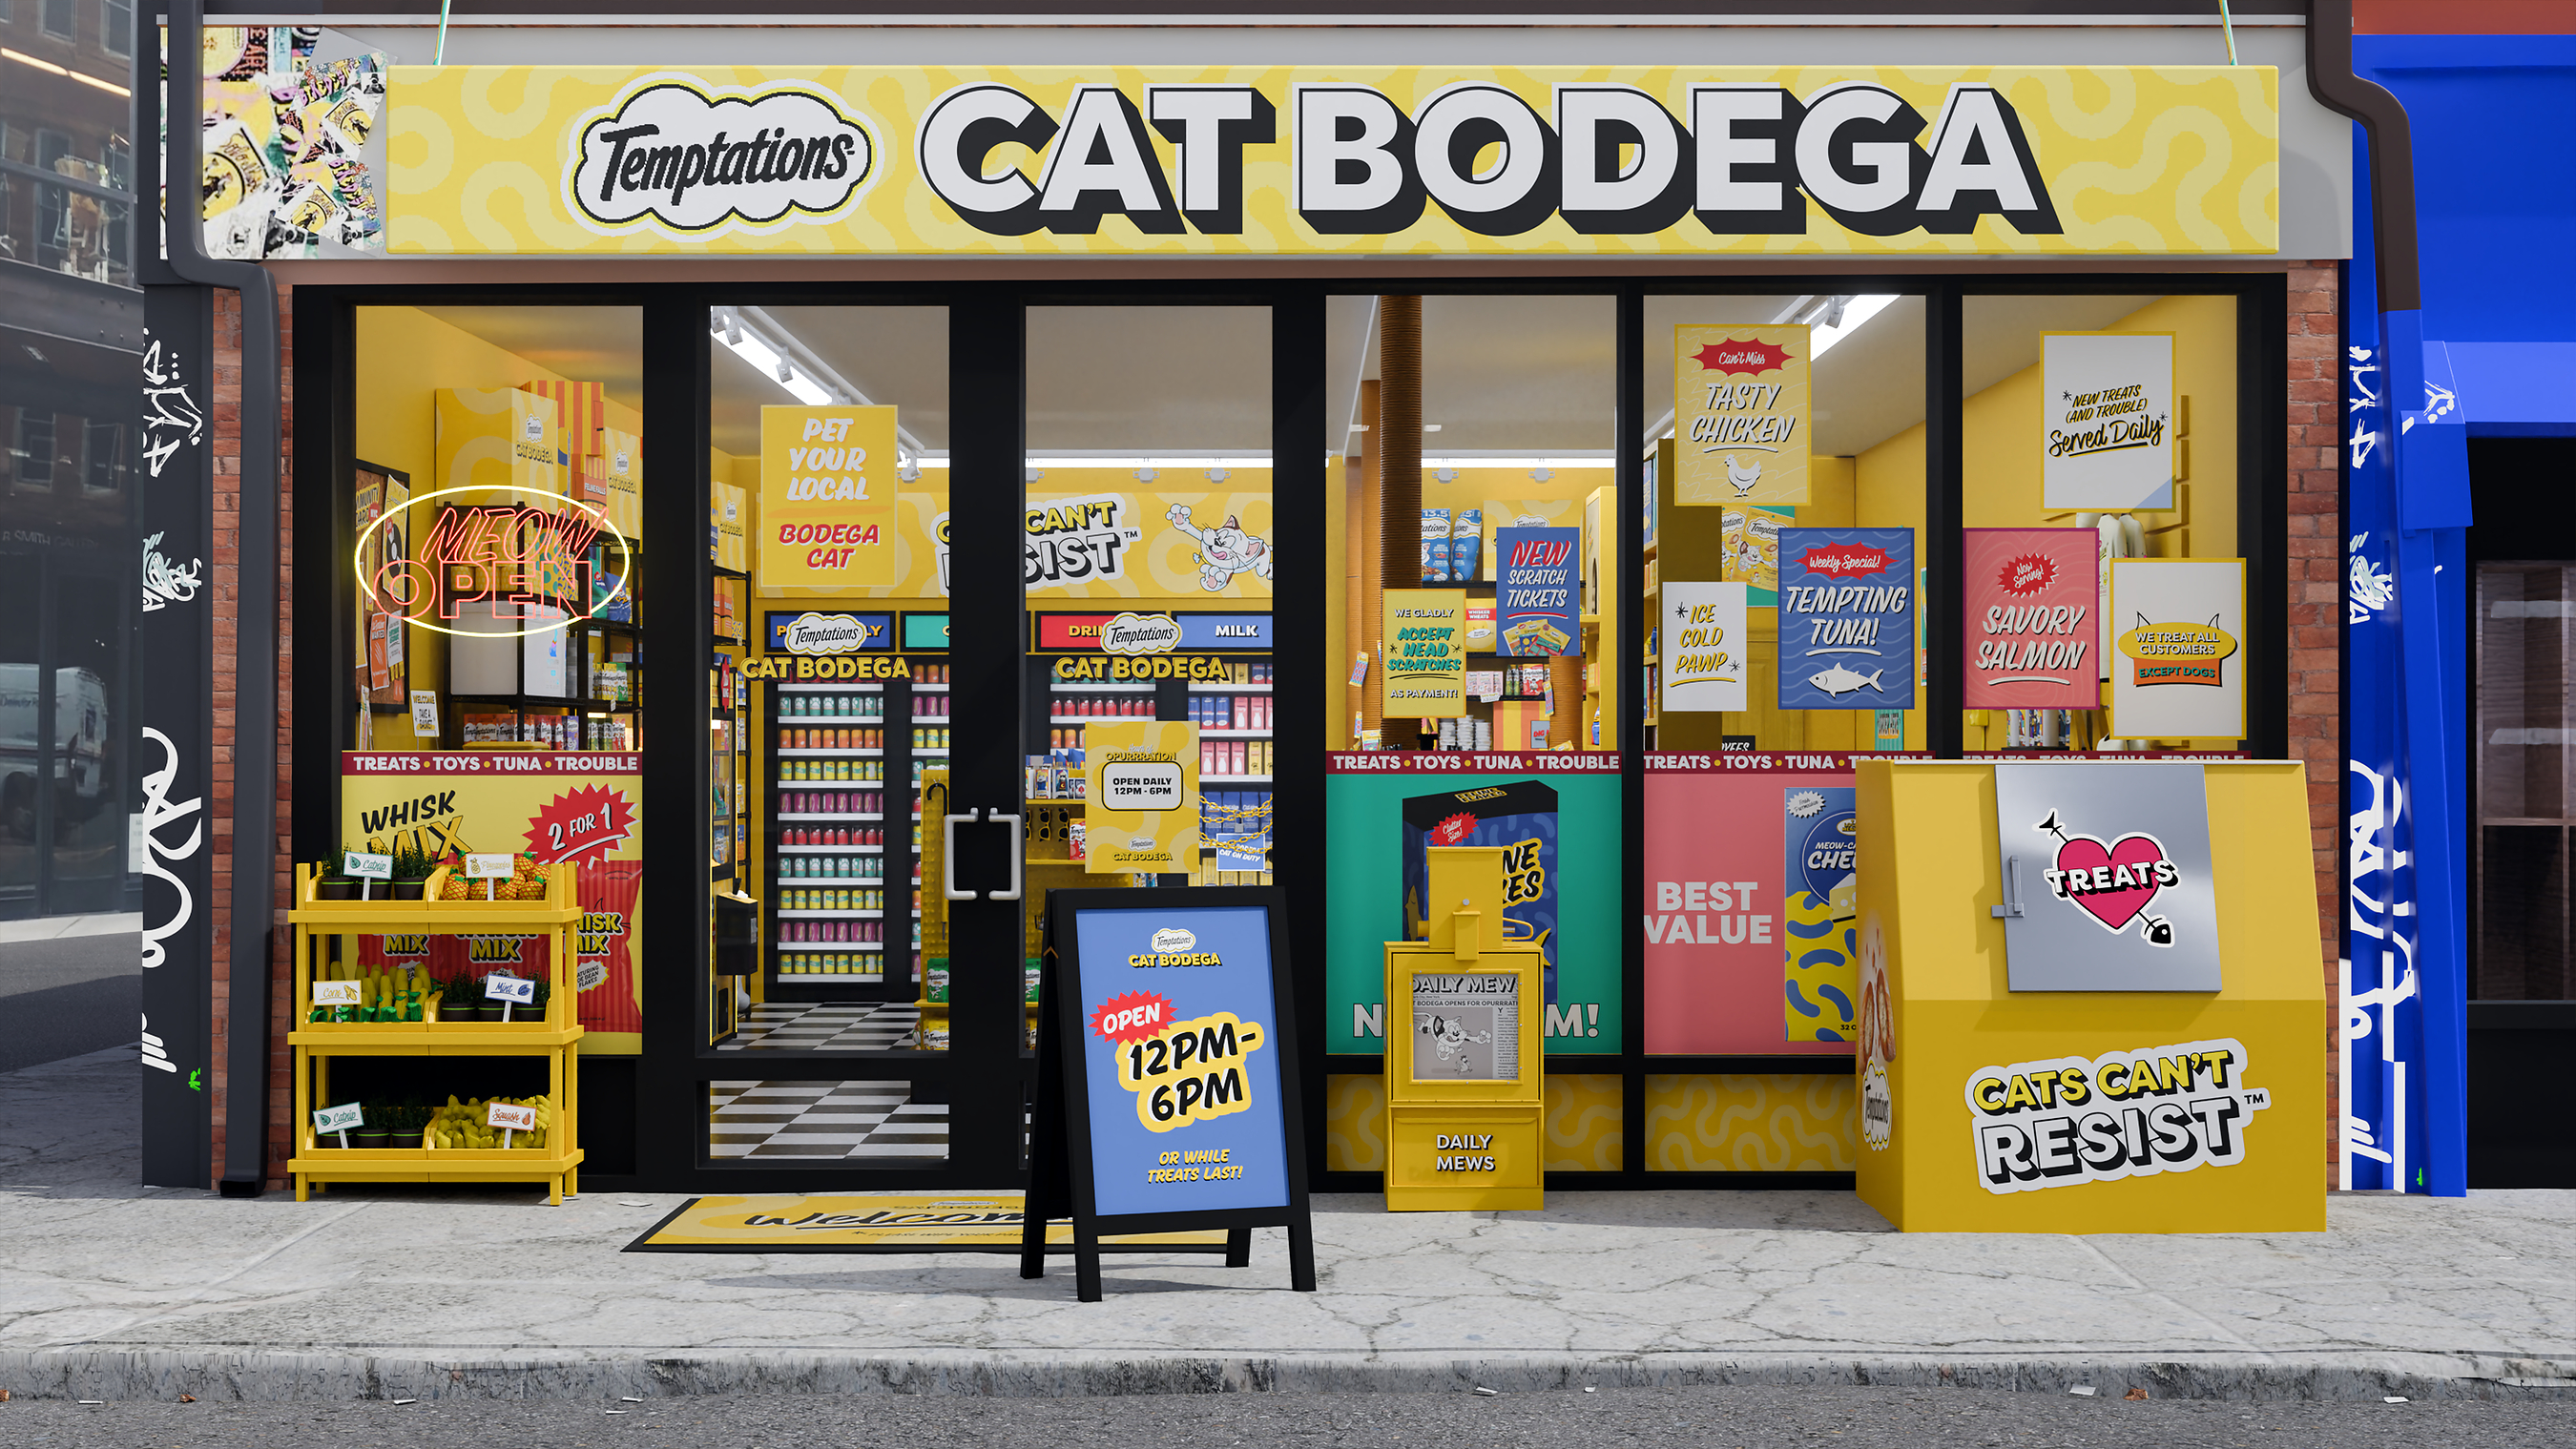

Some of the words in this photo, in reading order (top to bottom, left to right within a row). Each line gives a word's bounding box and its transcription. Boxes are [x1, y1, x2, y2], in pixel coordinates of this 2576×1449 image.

[600, 124, 854, 205] Temptations
[918, 84, 1275, 236] CAT
[1298, 82, 2064, 236] BODEGA
[1718, 351, 1744, 364] Can't
[1745, 352, 1765, 365] Miss
[1706, 383, 1781, 410] TASTY
[2072, 391, 2100, 407] NEW
[2102, 383, 2142, 403] TREATS
[2066, 408, 2093, 424] (AND
[2097, 398, 2149, 419] TROUBLE)
[802, 418, 854, 443] PET
[1690, 415, 1796, 443] CHICKEN
[2048, 422, 2108, 457] Served
[2109, 414, 2165, 446] Daily
[789, 447, 866, 472] YOUR
[786, 476, 870, 502] LOCAL
[1423, 524, 1447, 532] ations
[1722, 517, 1744, 528] tations
[420, 507, 610, 565] MEOW
[779, 524, 879, 546] BODEGA
[806, 548, 855, 569] CAT
[1509, 539, 1571, 568] NEW
[1810, 555, 1840, 572] Weekly
[1842, 555, 1880, 572] Special!
[1507, 569, 1568, 586] SCRATCH
[2013, 564, 2044, 589] Serving!
[2017, 562, 2033, 576] Now
[373, 560, 592, 619] OPEN
[1506, 589, 1568, 609] TICKETS
[1786, 586, 1908, 613] TEMPTING
[1395, 609, 1411, 618] WE
[1413, 608, 1454, 619] GLADLY
[1690, 604, 1716, 624] ICE
[1982, 605, 2087, 635] SAVORY
[794, 626, 859, 646] Temptations
[1111, 626, 1174, 646] Temptations
[1215, 625, 1259, 638] MILK
[1397, 627, 1455, 642] ACCEPT
[1679, 627, 1723, 648] COLD
[1810, 618, 1880, 646] TUNA!
[2135, 631, 2155, 643] WE
[2157, 631, 2195, 643] TREAT
[2197, 631, 2220, 643] ALL
[1403, 643, 1449, 657] HEAD
[1975, 640, 2087, 671] SALMON
[2139, 644, 2215, 655] CUSTOMERS
[739, 656, 793, 680] CAT
[798, 656, 913, 680] BODEGA
[1055, 656, 1109, 680] CAT
[1112, 656, 1230, 680] BODEGA
[1387, 658, 1462, 671] SCRATCHES
[1674, 652, 1728, 673] PAWP
[2139, 666, 2182, 678] EXCEPT
[2183, 666, 2215, 677] DOGS
[412, 694, 435, 705] WELCOME
[1390, 689, 1403, 698] AS
[1405, 689, 1458, 699] PAYMENT!
[353, 756, 420, 771] TREATS
[432, 756, 480, 771] TOYS
[493, 756, 542, 771] TUNA
[554, 756, 637, 771] TROUBLE
[1105, 752, 1176, 761] OPURRRATION
[1334, 756, 1401, 770] TREATS
[1413, 756, 1461, 770] TOYS
[1474, 756, 1523, 770] TUNA
[1536, 756, 1619, 770] TROUBLE
[1644, 756, 1711, 770] TREATS
[1723, 756, 1772, 770] TOYS
[1784, 756, 1836, 770] TUNA
[1112, 777, 1140, 786] OPEN
[1143, 777, 1172, 786] DAILY
[1114, 787, 1142, 796] 12PM
[1149, 787, 1172, 796] 6PM
[362, 790, 456, 834] WHISK
[548, 822, 566, 851] 2
[570, 813, 596, 838] FOR
[600, 802, 613, 830] 1
[1443, 819, 1462, 835] Clutter
[363, 859, 386, 872] Catnip
[1112, 852, 1132, 861] CAT
[1132, 852, 1173, 861] BODEGA
[1242, 852, 1260, 862] DUTY
[1808, 850, 1856, 871] CHE
[2046, 860, 2178, 898] TREATS
[1657, 882, 1757, 911] BEST
[1644, 915, 1772, 944] VALUE
[384, 935, 428, 955] MIX
[470, 939, 522, 962] MIX
[1156, 935, 1191, 947] Temptations
[1128, 954, 1157, 969] CAT
[1159, 952, 1222, 968] BODEGA
[577, 965, 599, 978] ATURING
[322, 988, 343, 999] Corn
[495, 981, 513, 994] Mint
[1467, 977, 1518, 993] MEW
[1103, 1003, 1160, 1034] OPEN
[1126, 1023, 1256, 1081] 12PM-
[1973, 1067, 2091, 1116] CATS
[2096, 1049, 2234, 1101] CAN'T
[1147, 1067, 1243, 1122] 6PM
[333, 1110, 358, 1124] Catnip
[492, 1108, 520, 1122] Squash
[1436, 1134, 1493, 1149] DAILY
[1981, 1096, 2240, 1184] RESIST
[1159, 1150, 1179, 1167] OR
[1184, 1149, 1231, 1166] WHILE
[1436, 1155, 1495, 1171] MEWS
[1148, 1168, 1199, 1184] TREATS
[1203, 1166, 1243, 1182] LAST!
[744, 1211, 1026, 1227] Welcom
